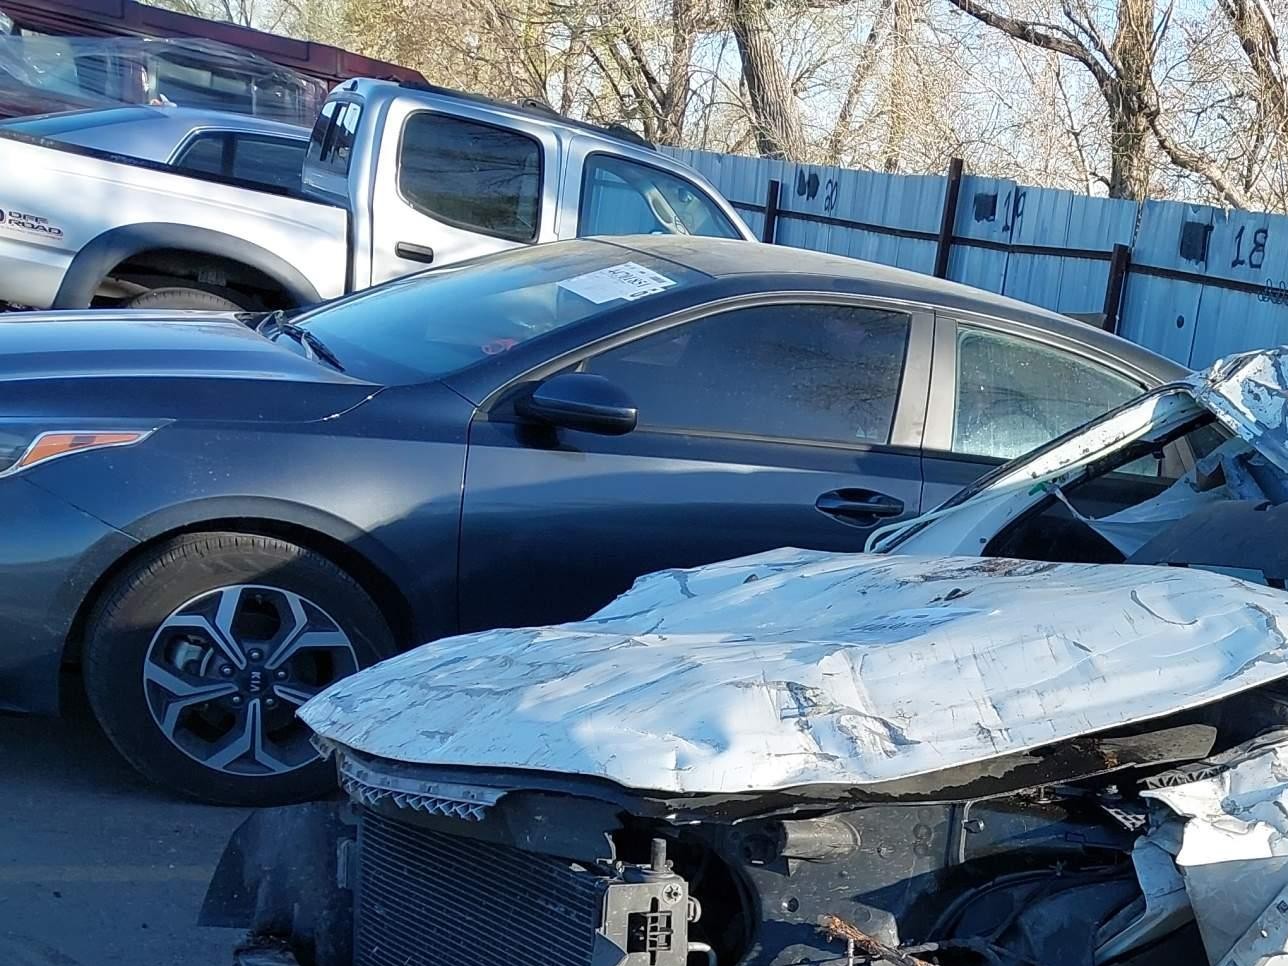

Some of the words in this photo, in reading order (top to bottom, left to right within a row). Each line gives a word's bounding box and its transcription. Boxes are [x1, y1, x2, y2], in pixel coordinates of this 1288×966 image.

[823, 178, 839, 213] 20
[8, 210, 49, 225] OFF
[8, 218, 64, 236] ROAD
[1001, 189, 1027, 238] 19
[1230, 224, 1270, 269] 18
[249, 671, 262, 692] KIA
